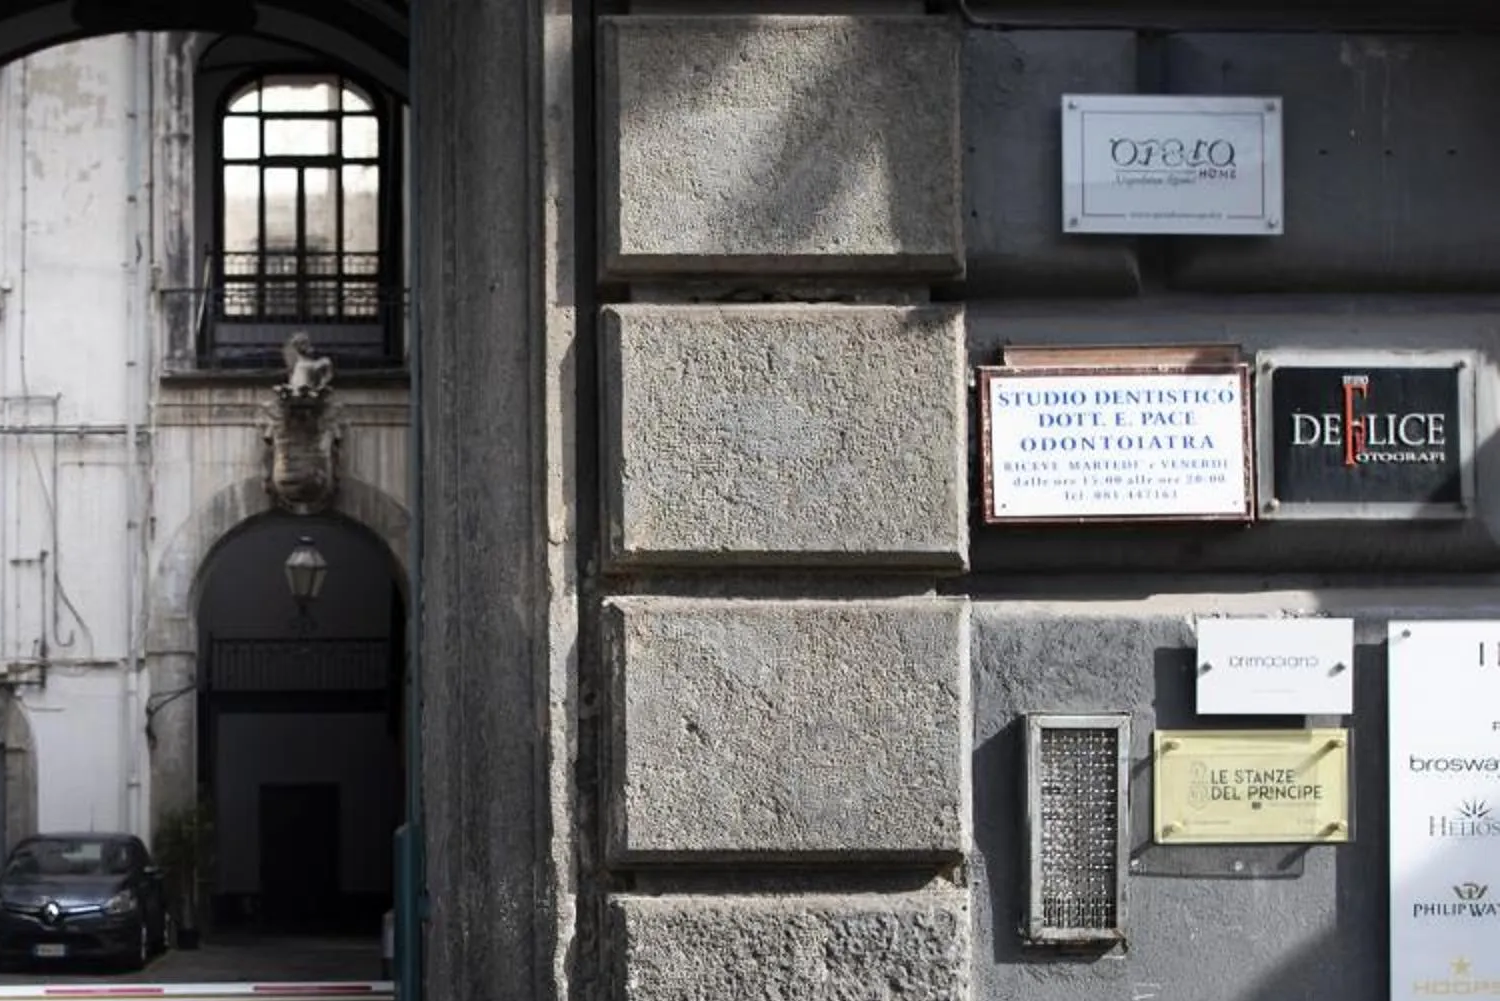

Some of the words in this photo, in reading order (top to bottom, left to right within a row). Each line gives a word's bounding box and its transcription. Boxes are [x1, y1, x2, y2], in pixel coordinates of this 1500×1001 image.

[1198, 170, 1237, 179] HOME
[998, 390, 1087, 406] STUDIO
[1095, 388, 1234, 405] DENTISTICO
[1142, 411, 1196, 426] PACE
[1020, 434, 1215, 451] ODONTOIATRA
[1409, 753, 1500, 772] broswa
[1210, 769, 1229, 785] LE
[1235, 768, 1296, 784] STANZE
[1211, 785, 1241, 801] DEL
[1247, 784, 1323, 800] PRINCIPE
